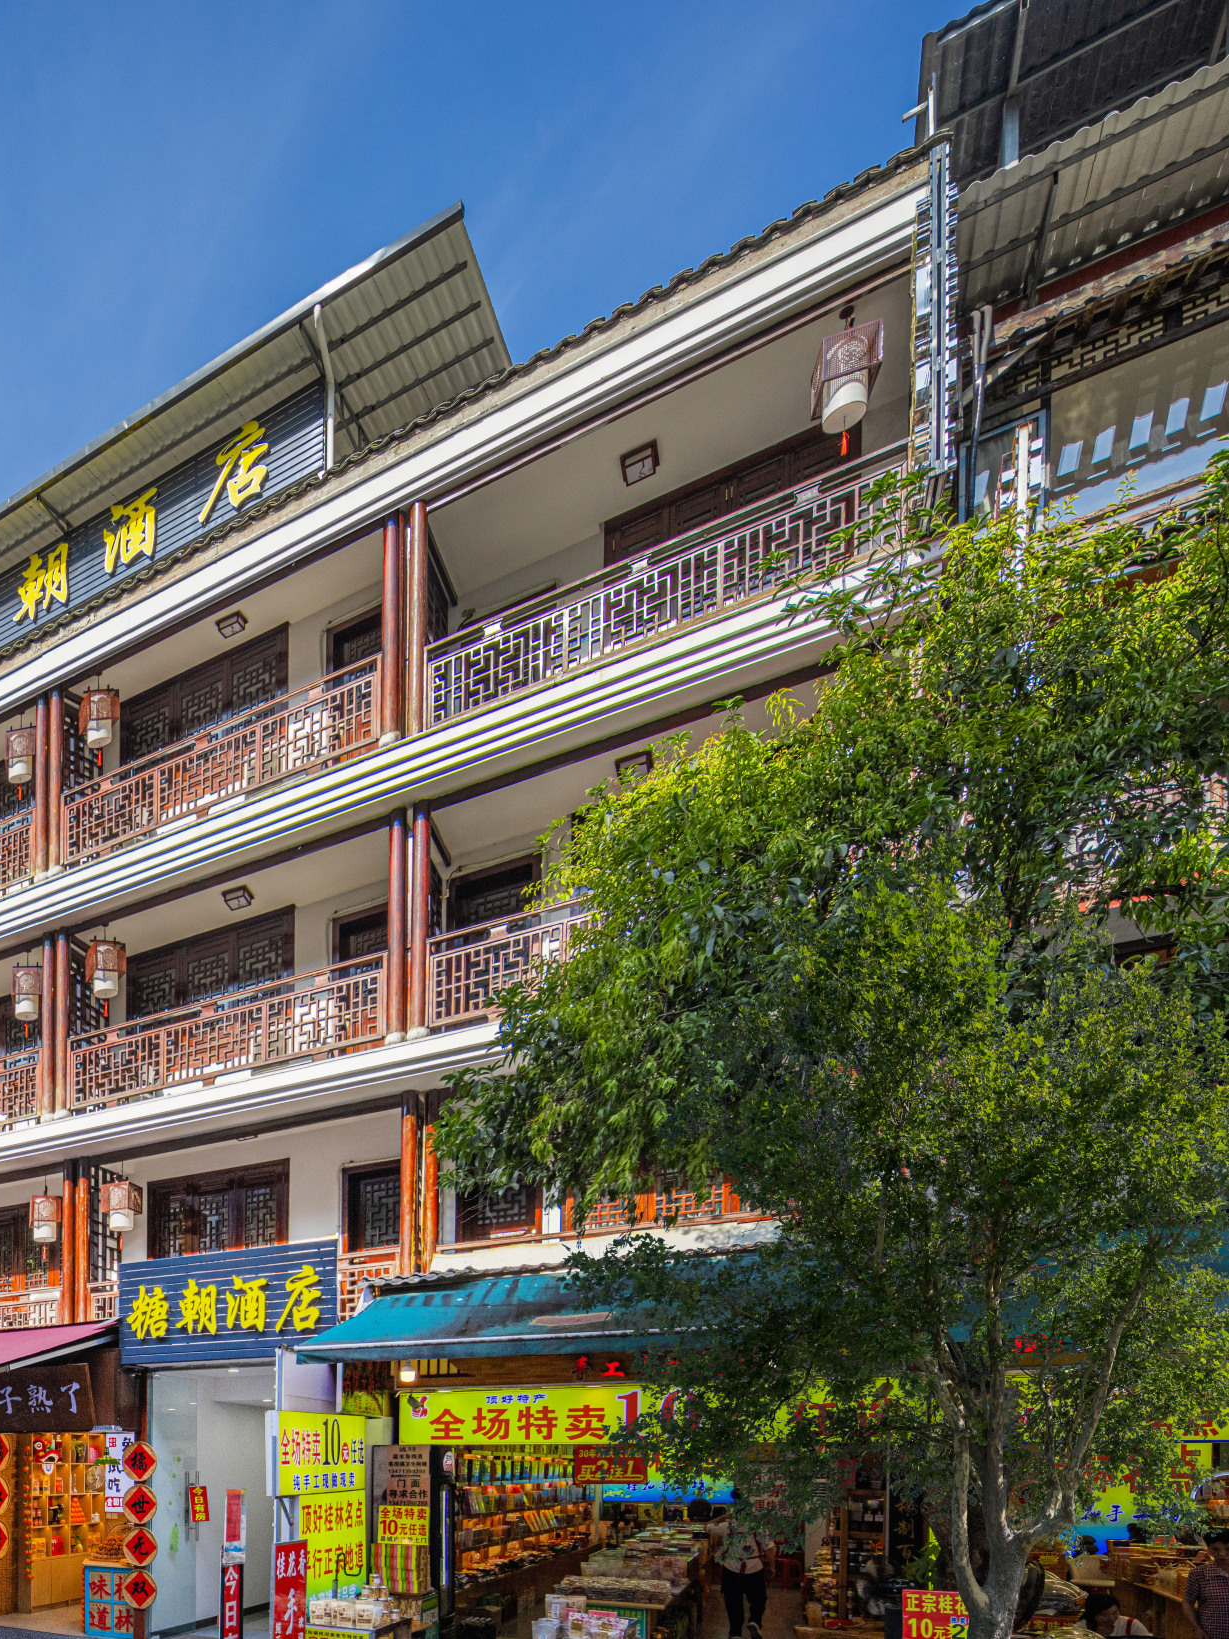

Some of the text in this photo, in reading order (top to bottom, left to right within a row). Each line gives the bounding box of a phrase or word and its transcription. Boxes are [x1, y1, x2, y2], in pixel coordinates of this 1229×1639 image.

[127, 1264, 322, 1340] 糖朝酒店
[485, 1392, 548, 1406] 顶好特产
[280, 1418, 365, 1467] 全场特卖10元任选
[292, 1471, 356, 1491] 纯手工现做现卖
[396, 1478, 421, 1489] 门面
[192, 1486, 207, 1522] 今日有房
[388, 1489, 429, 1499] 寻求合作
[129, 1451, 150, 1598] 橘世无双
[301, 1498, 365, 1535] 顶好桂林名点
[380, 1506, 428, 1521] 全场特卖
[379, 1519, 428, 1537] 10元任选
[89, 1574, 112, 1631] 味道
[905, 1593, 969, 1616] 正宗桂花
